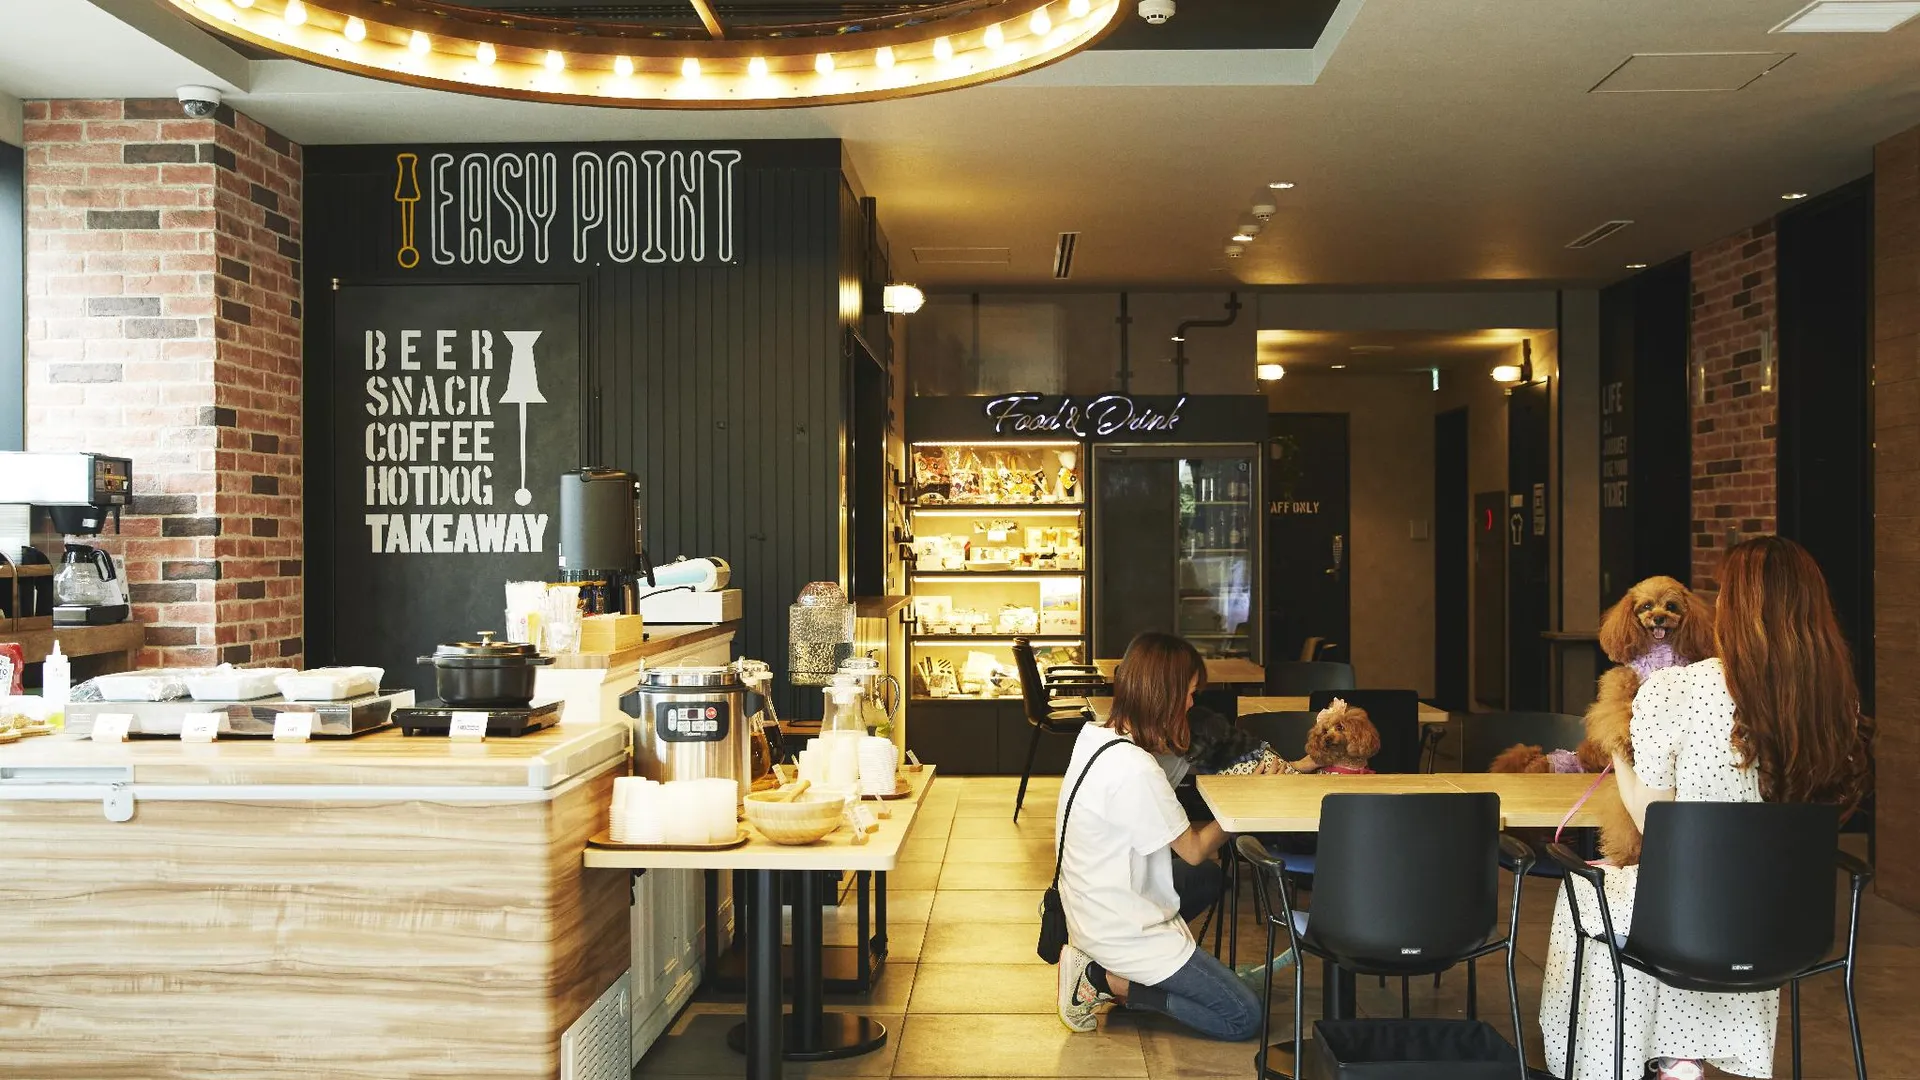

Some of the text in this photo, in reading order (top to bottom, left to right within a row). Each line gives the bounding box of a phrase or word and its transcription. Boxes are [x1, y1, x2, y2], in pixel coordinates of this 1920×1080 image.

[430, 150, 742, 264] EASY POINT
[365, 330, 494, 371] BEER
[365, 375, 492, 416] SNACK
[986, 395, 1186, 437] Food & Drink
[1602, 382, 1623, 415] LIFE
[365, 421, 494, 462] COFFEE
[365, 465, 494, 506] HOTDOG
[1268, 500, 1320, 514] AFF ONLY
[365, 513, 549, 553] TAKEAWAY
